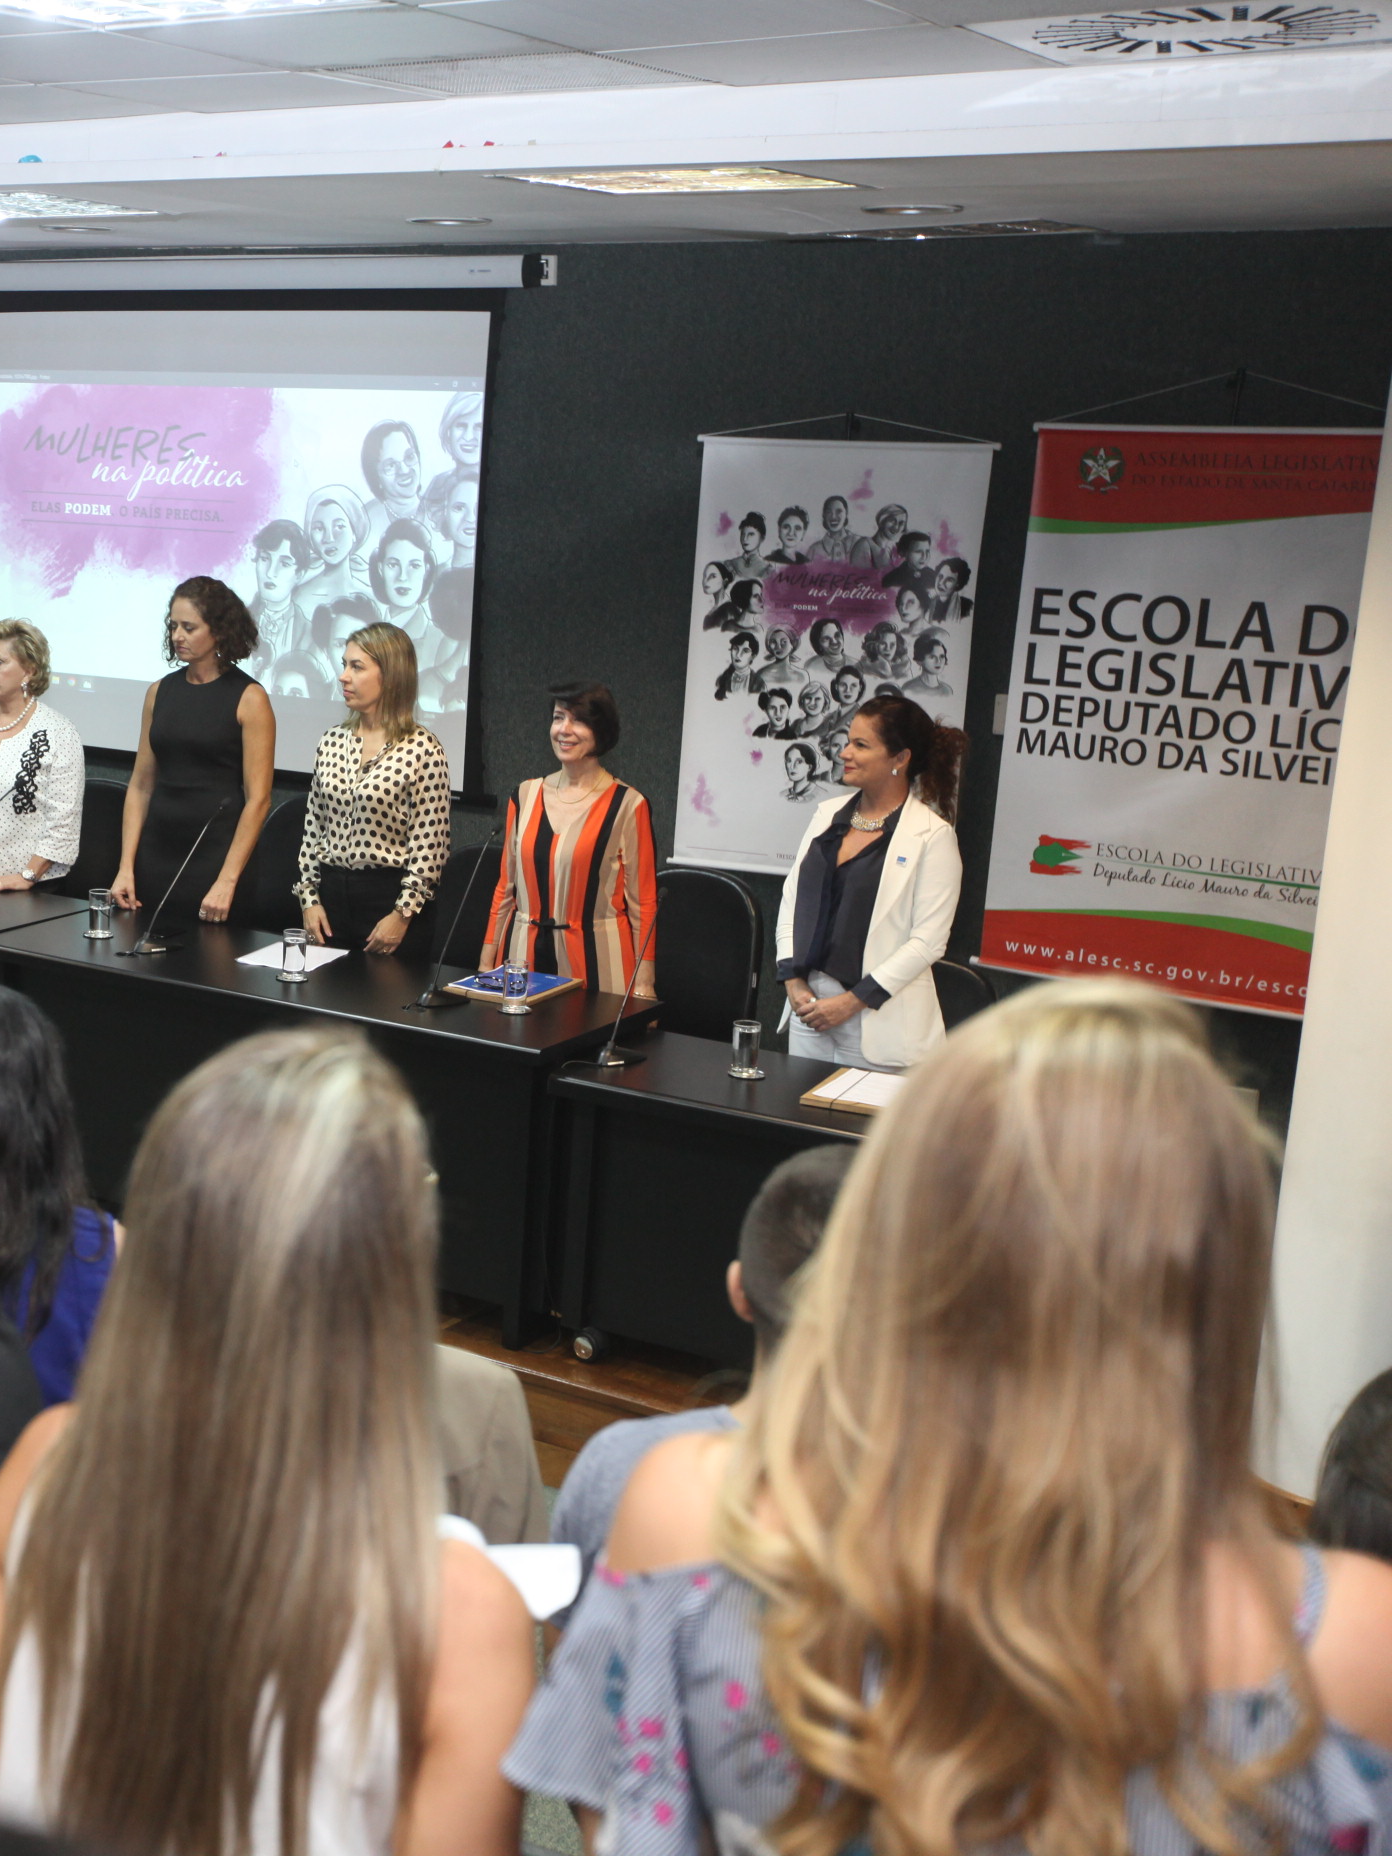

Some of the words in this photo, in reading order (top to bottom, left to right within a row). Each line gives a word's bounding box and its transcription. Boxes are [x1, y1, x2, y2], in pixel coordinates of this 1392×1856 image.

[24, 422, 207, 468] MULHERES
[91, 462, 132, 482] na
[126, 448, 248, 502] política
[31, 501, 62, 514] ELAS
[119, 506, 128, 518] O
[133, 504, 161, 520] PAÍS
[165, 507, 224, 523] PRECISA.
[773, 572, 868, 591] MULHERES
[808, 588, 828, 598] na
[826, 583, 888, 605] política
[1029, 587, 1275, 653] ESCOLA
[1298, 604, 1357, 657] D
[1024, 642, 1351, 711] LEGISLATIV
[1019, 691, 1257, 745] DEPUTADO
[1016, 727, 1148, 766] MAURO
[1157, 741, 1208, 773] DA
[1096, 842, 1165, 866] ESCOLA
[1172, 853, 1203, 870] DO
[1093, 862, 1156, 887] Deputado
[1160, 873, 1195, 891] Lício
[1199, 878, 1249, 898] Mauro
[1253, 882, 1272, 901] da
